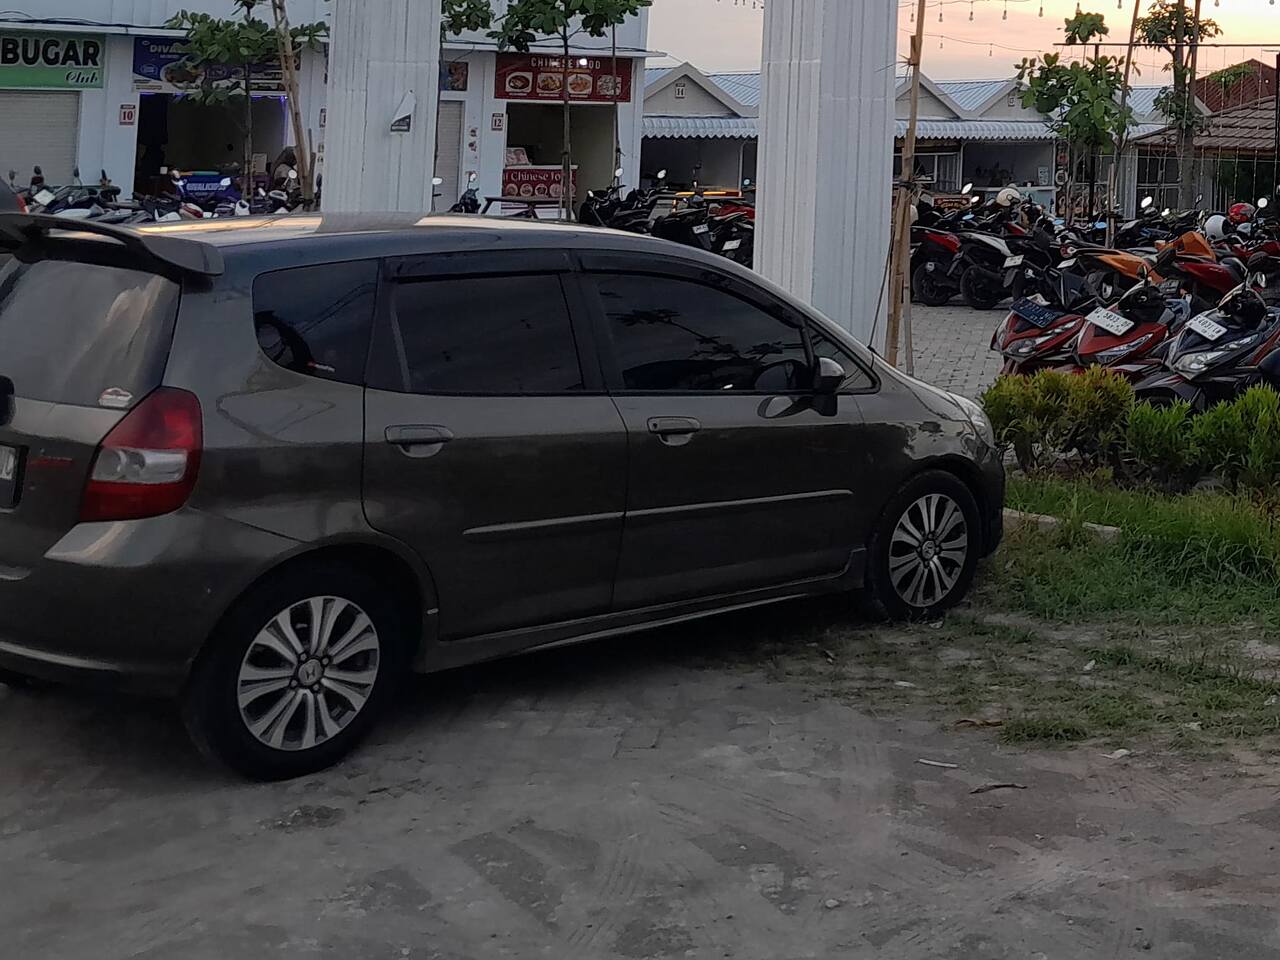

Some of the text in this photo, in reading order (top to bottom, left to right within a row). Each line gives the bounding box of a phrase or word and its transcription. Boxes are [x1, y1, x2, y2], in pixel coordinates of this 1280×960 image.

[1, 38, 100, 66] BUGAR
[65, 71, 98, 83] Club
[122, 110, 134, 121] 10
[493, 117, 502, 128] 12
[511, 171, 549, 181] Chinese
